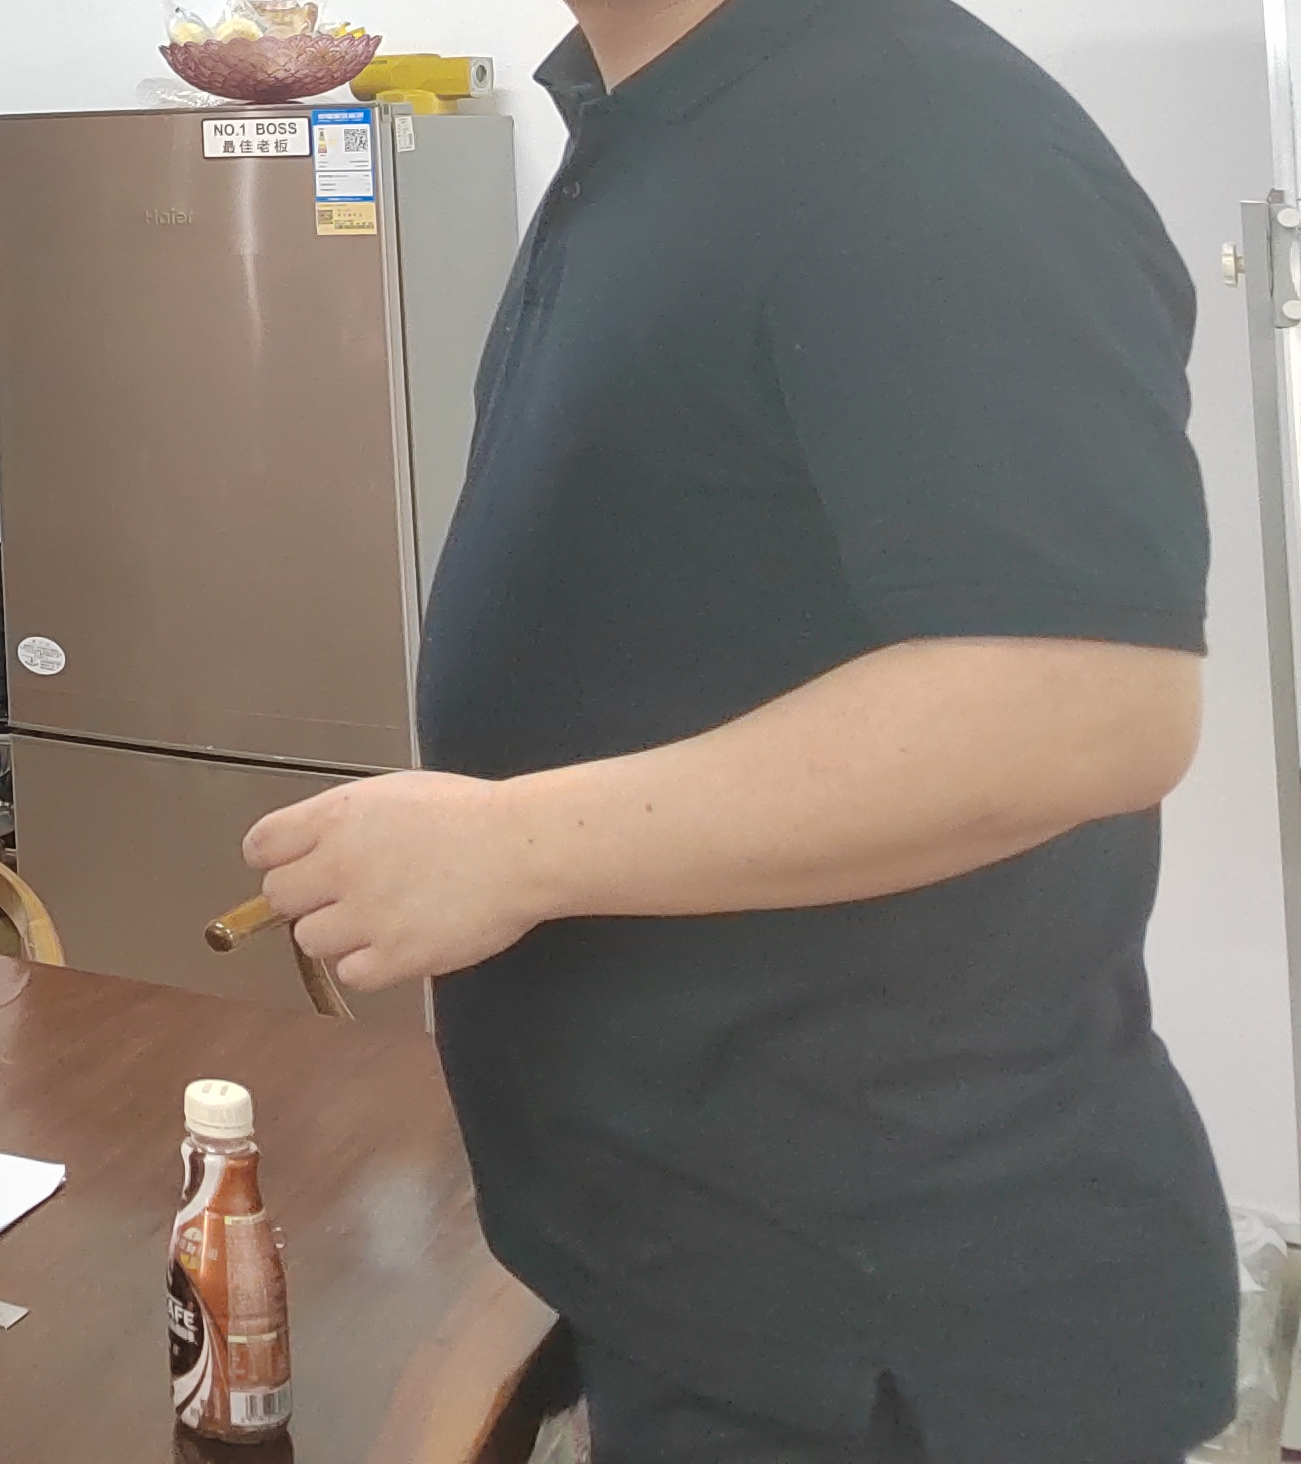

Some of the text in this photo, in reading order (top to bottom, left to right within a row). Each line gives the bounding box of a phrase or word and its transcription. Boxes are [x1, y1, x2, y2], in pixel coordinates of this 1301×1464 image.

[214, 122, 297, 137] NO.1 BOSS
[222, 138, 290, 153] 最佳老板
[146, 209, 194, 226] Haier
